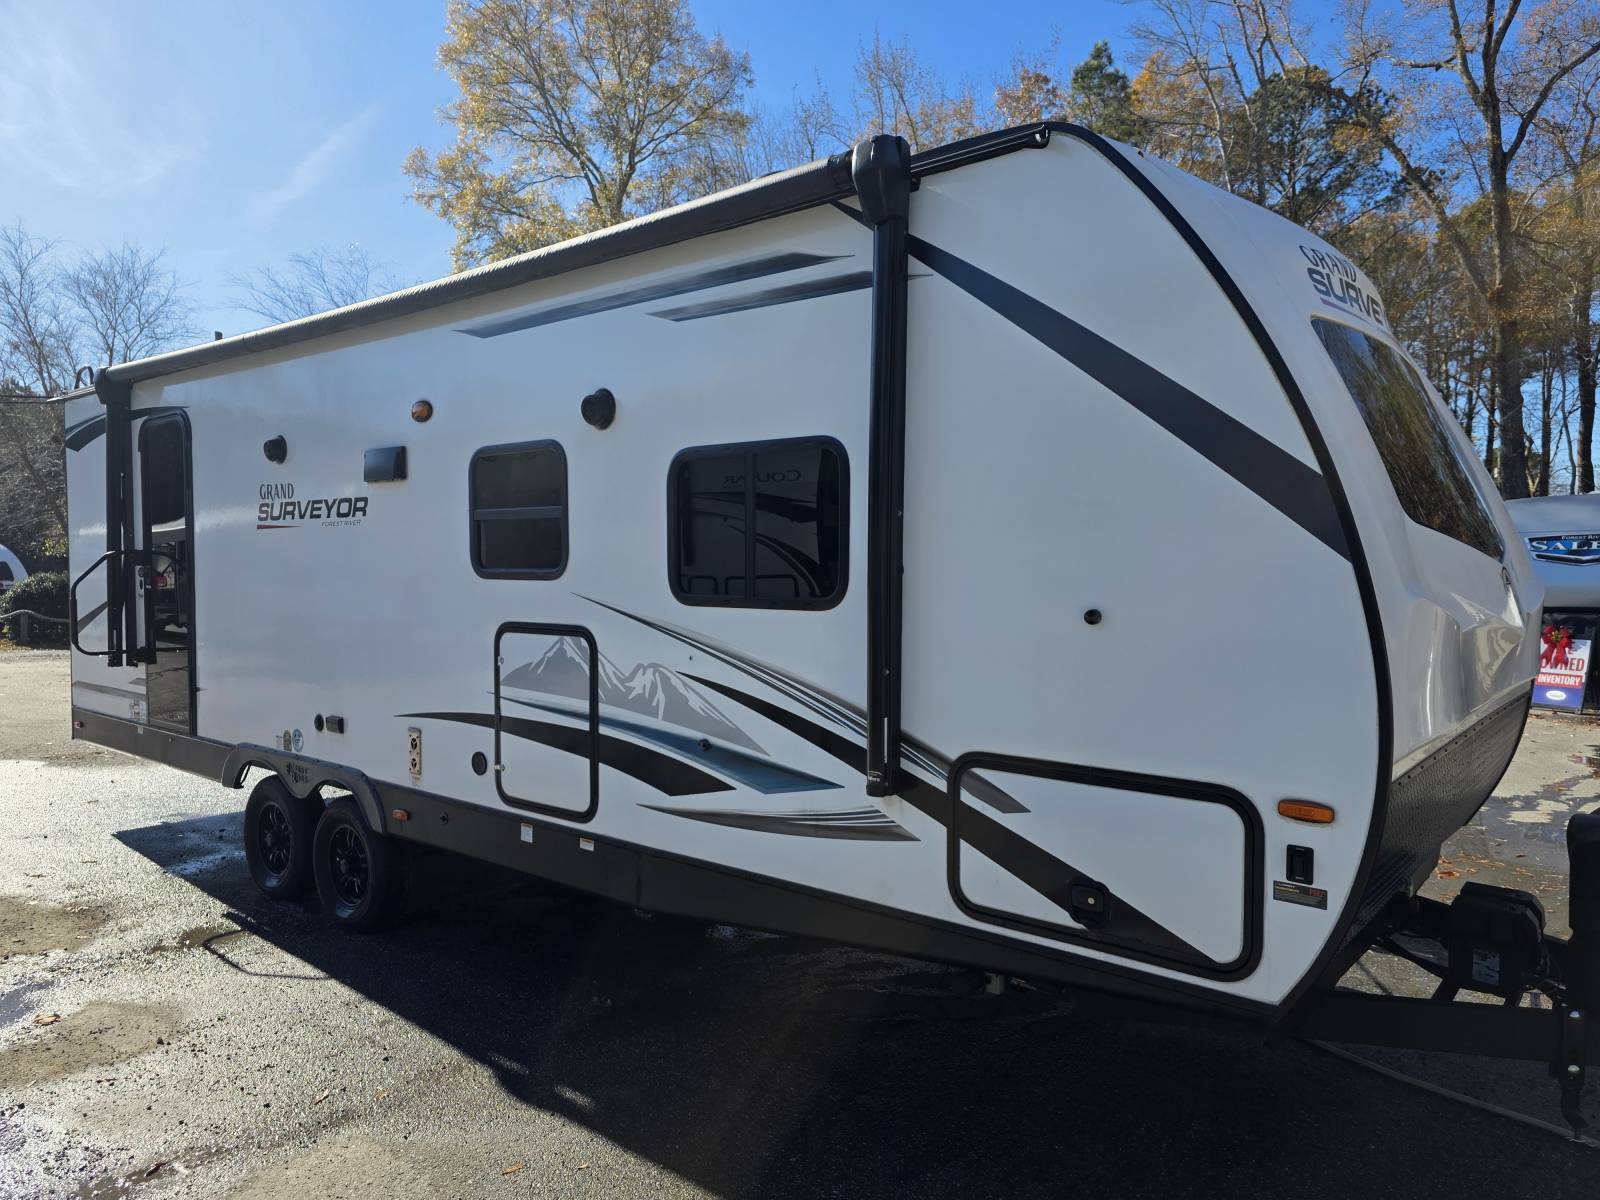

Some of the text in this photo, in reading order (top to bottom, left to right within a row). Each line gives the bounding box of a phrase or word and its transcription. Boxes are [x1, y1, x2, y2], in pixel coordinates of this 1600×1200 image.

[1299, 245, 1357, 282] GRAND
[1307, 267, 1385, 326] SURVE
[259, 482, 295, 501] GRAND
[257, 496, 369, 522] SURVEYOR
[1537, 673, 1581, 687] INVENTORY
